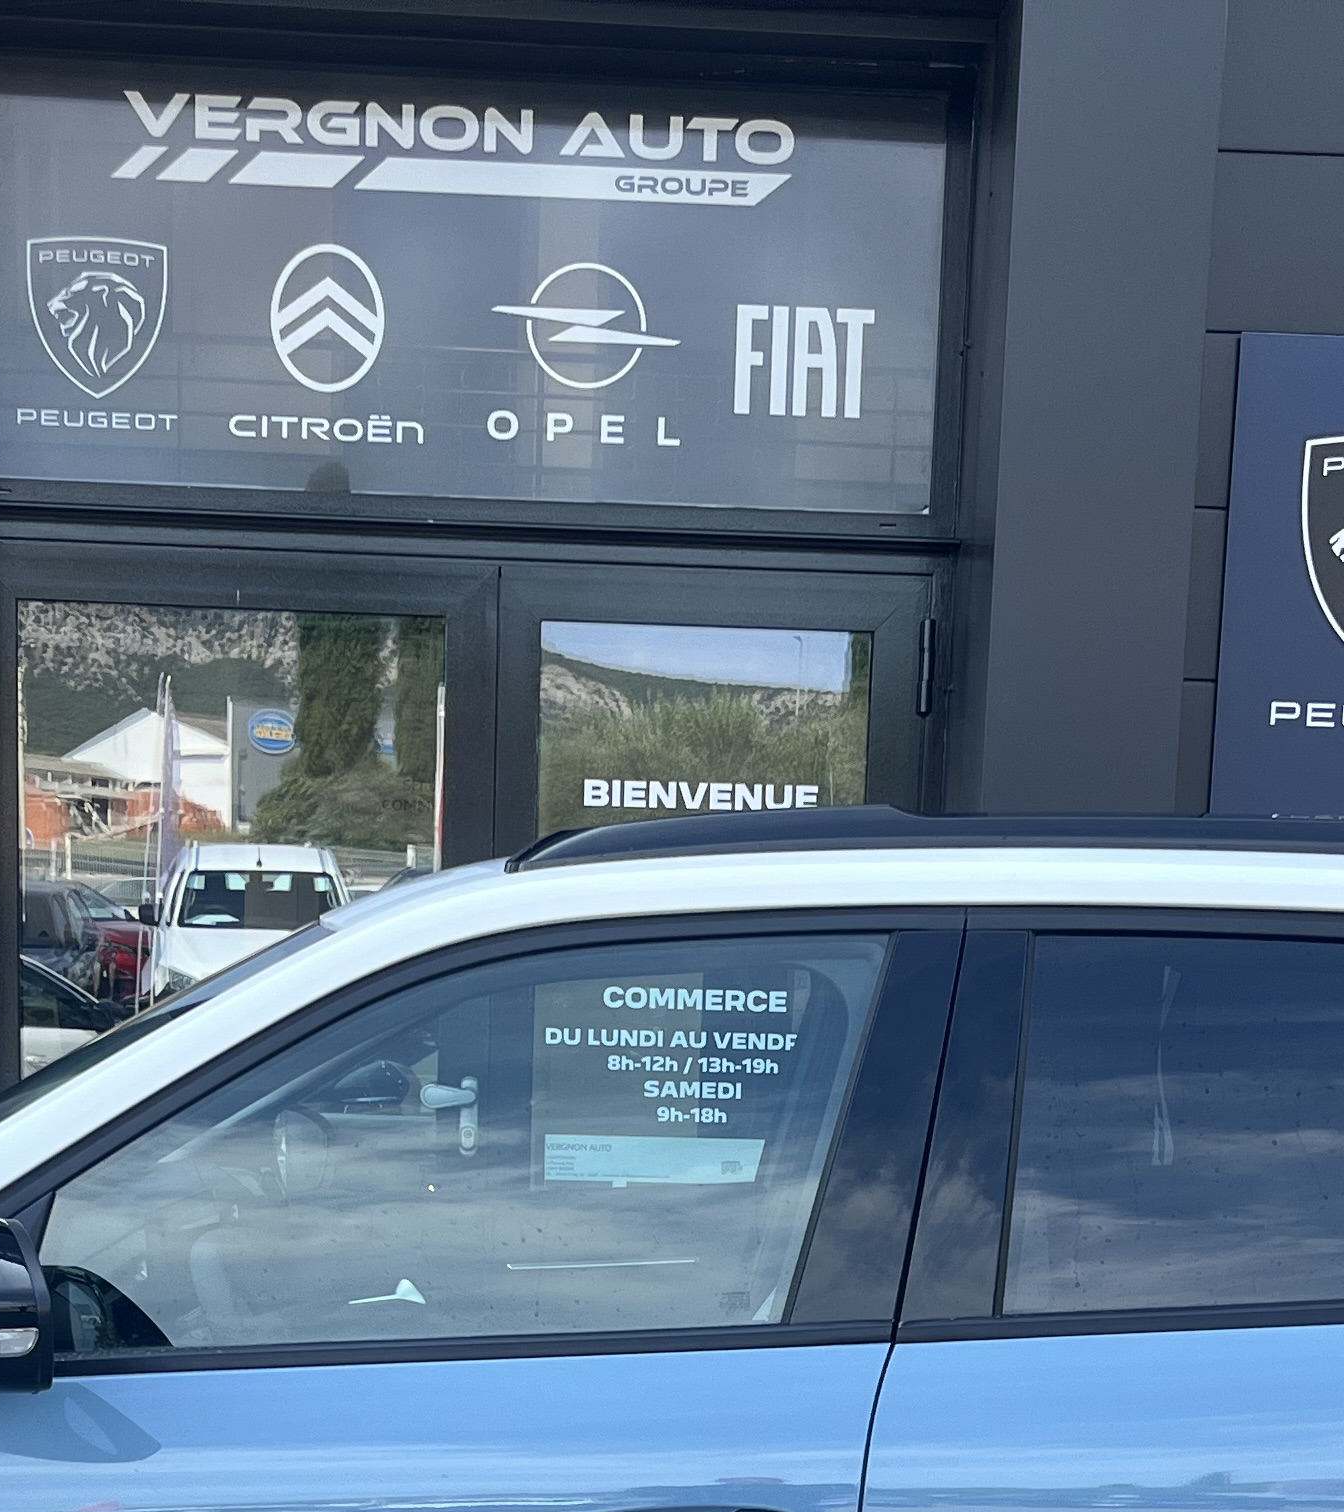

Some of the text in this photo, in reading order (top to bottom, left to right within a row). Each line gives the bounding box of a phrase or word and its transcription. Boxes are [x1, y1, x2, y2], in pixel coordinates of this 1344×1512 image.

[123, 90, 796, 165] VERGNON AUTO
[614, 174, 750, 199] GROUPE
[38, 248, 155, 271] PEUGEOT
[733, 303, 876, 419] FIAT
[16, 408, 178, 432] PEUGEOT
[228, 414, 424, 445] CITROËN
[487, 410, 681, 446] OPEL
[583, 778, 819, 811] BIENVENUE
[603, 985, 788, 1013] COMMERCE
[545, 1027, 582, 1046] DU
[587, 1028, 664, 1048] LUNDI
[669, 1030, 707, 1049] AU
[607, 1054, 779, 1075] 8h-12h / 13h-19h
[643, 1080, 742, 1100] SAMEDI
[656, 1106, 727, 1124] 9h-18h
[545, 1143, 612, 1152] VERGNON AUTO
